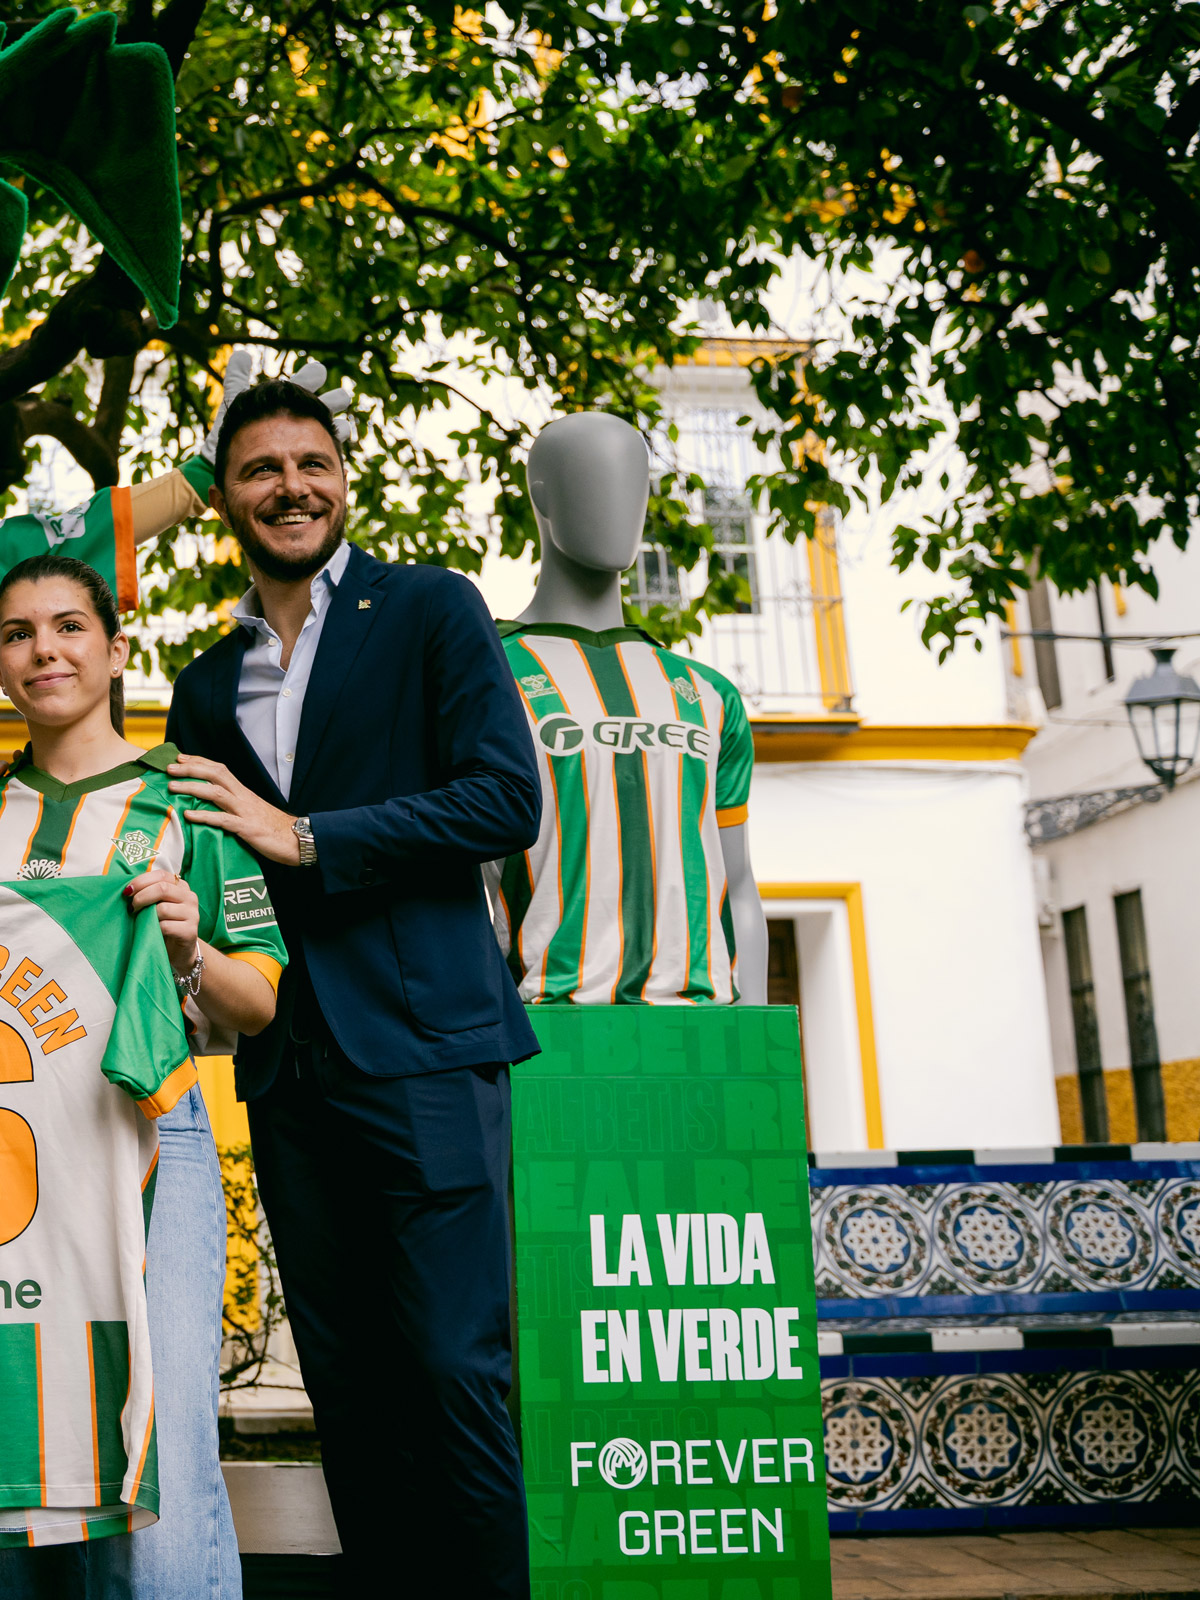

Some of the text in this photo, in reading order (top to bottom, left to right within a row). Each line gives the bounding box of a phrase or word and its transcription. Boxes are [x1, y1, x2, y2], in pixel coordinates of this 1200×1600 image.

[593, 721, 711, 757] GREE
[590, 1214, 653, 1286] LA
[656, 1213, 776, 1286] VIDA
[580, 1310, 642, 1383] EN
[648, 1307, 803, 1382] VERDE
[618, 1508, 784, 1556] GREEN
